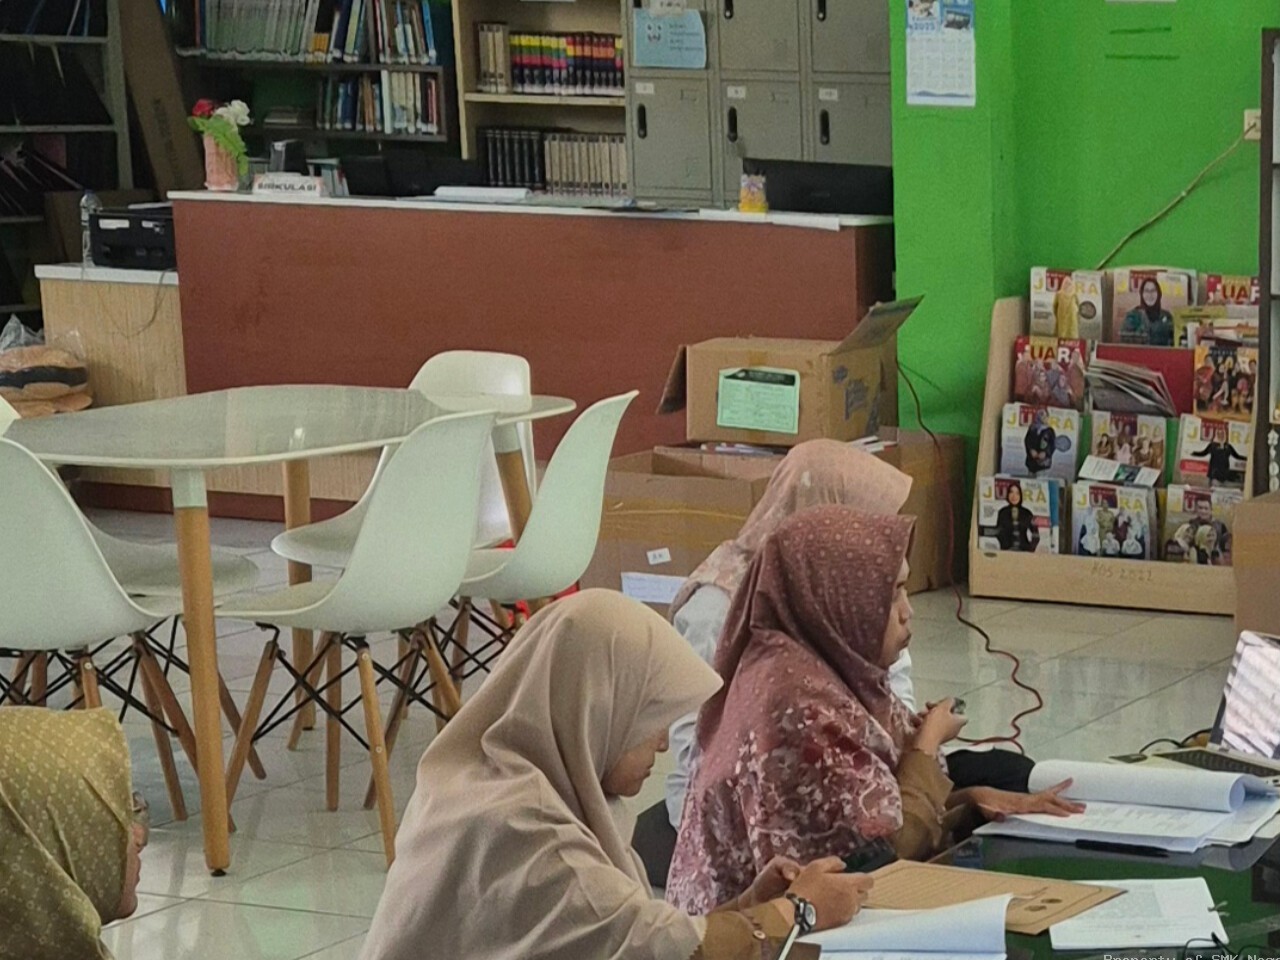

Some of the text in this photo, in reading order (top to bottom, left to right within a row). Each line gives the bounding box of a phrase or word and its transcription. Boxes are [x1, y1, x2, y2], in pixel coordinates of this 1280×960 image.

[1033, 277, 1099, 296] JURA
[1006, 411, 1074, 431] JURA
[982, 485, 1047, 504] JURA
[1076, 493, 1144, 511] JURA
